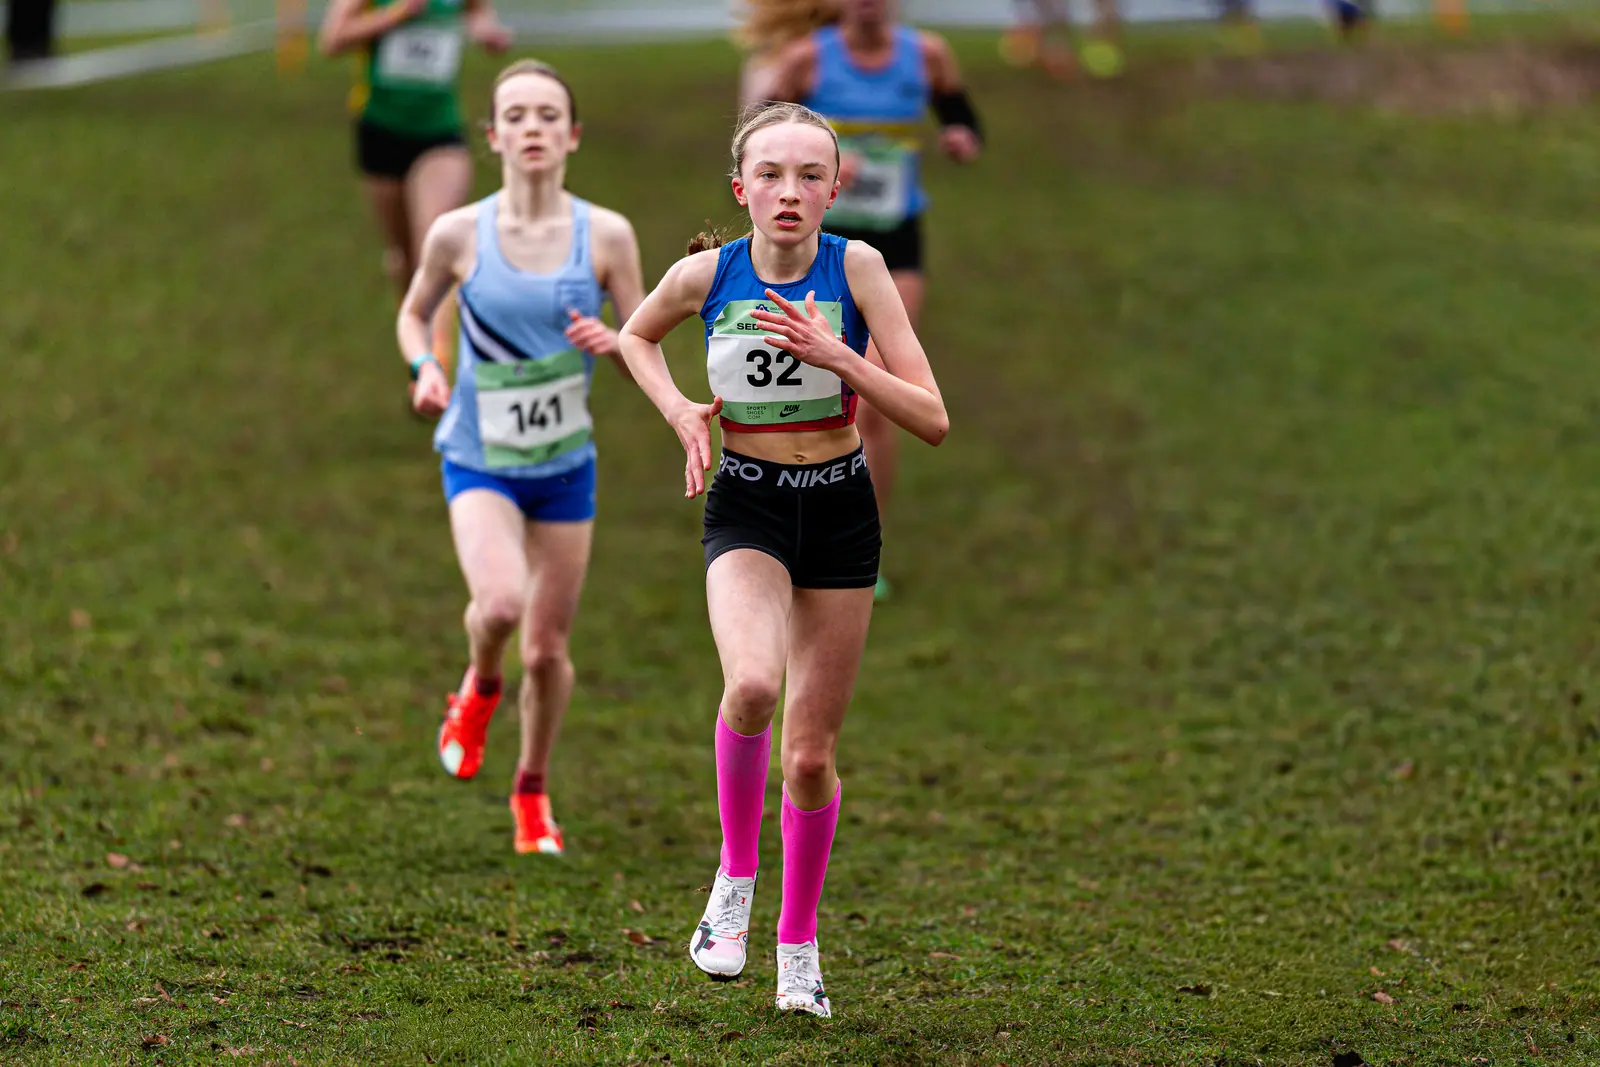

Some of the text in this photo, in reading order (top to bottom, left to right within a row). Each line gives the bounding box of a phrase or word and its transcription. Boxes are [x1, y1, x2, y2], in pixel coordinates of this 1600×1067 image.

[746, 349, 803, 388] 32
[508, 393, 563, 435] 141
[783, 404, 801, 412] RUN
[776, 461, 847, 488] NIKE
